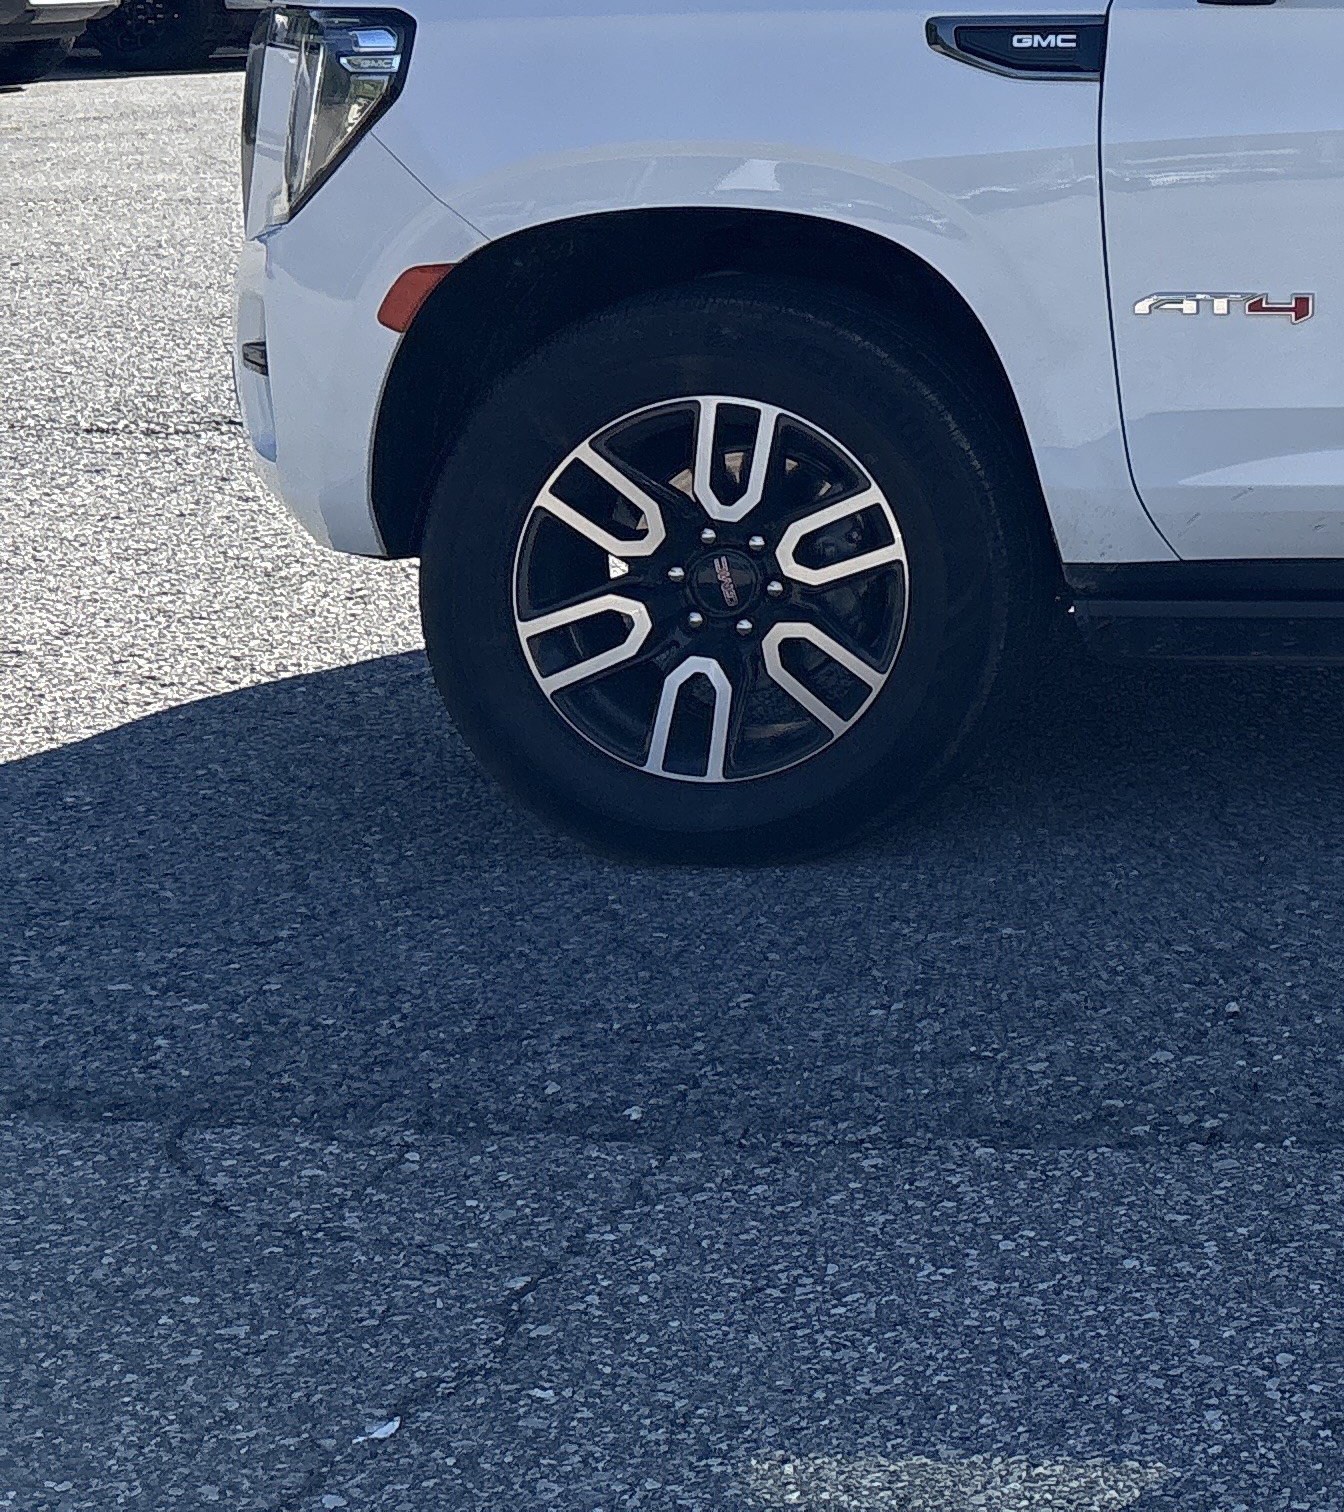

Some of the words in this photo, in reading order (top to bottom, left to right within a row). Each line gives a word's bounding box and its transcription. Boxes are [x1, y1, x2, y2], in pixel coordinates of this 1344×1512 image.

[1012, 33, 1077, 48] GMC
[360, 59, 392, 68] GMC
[1133, 292, 1314, 324] AT4
[713, 555, 738, 607] GMC
